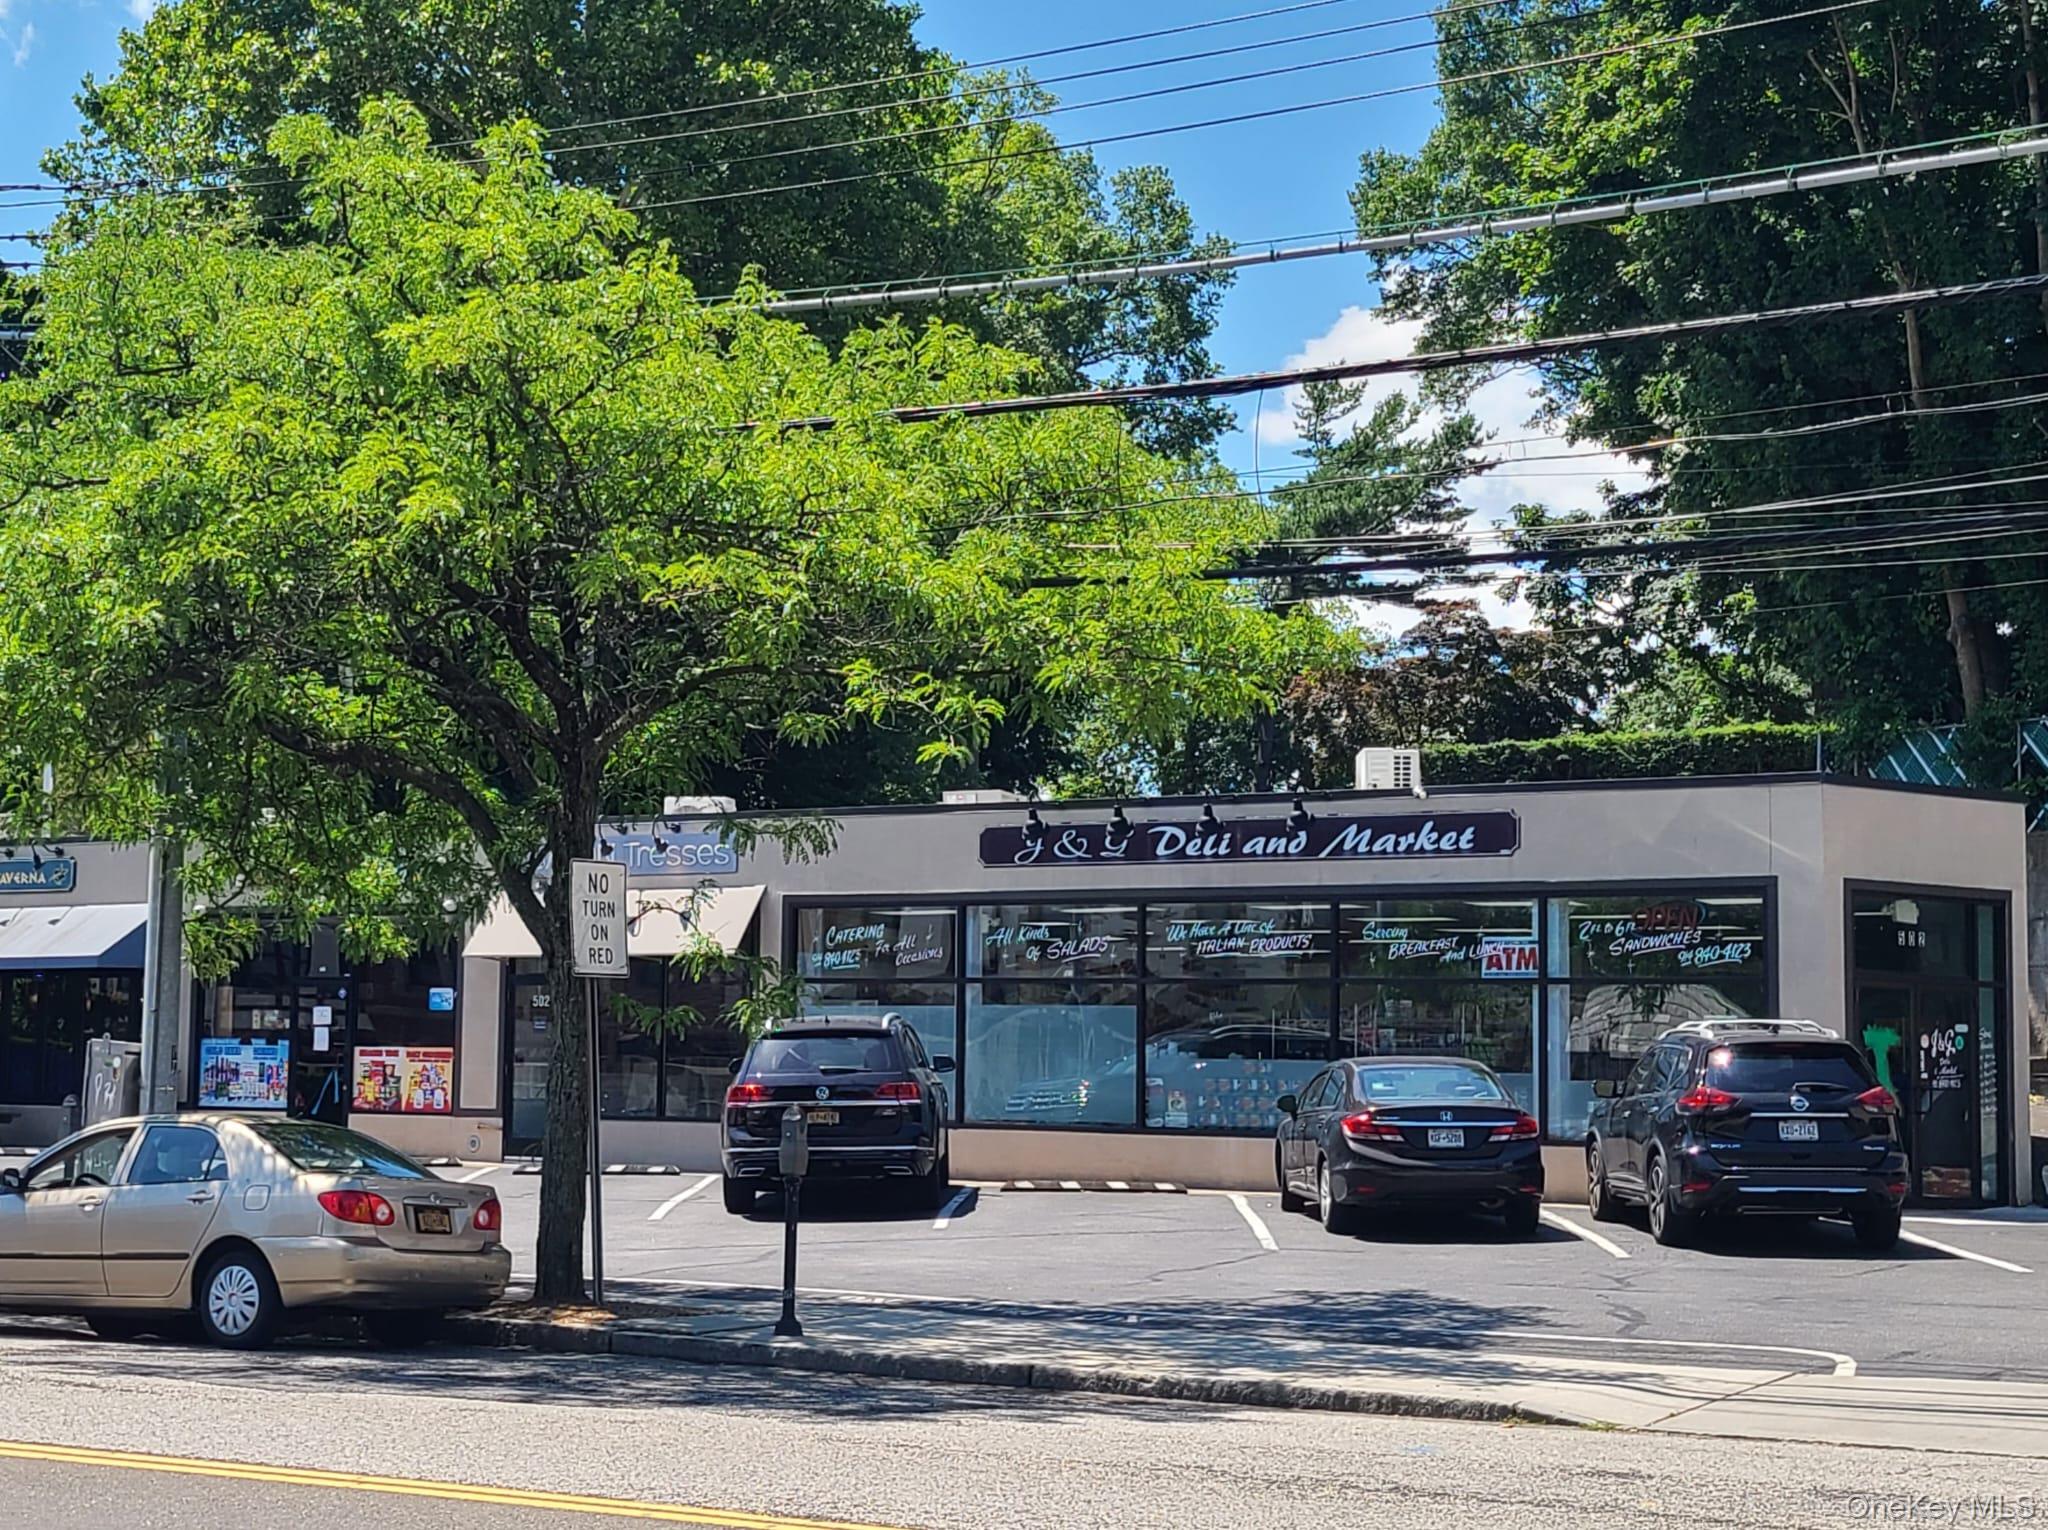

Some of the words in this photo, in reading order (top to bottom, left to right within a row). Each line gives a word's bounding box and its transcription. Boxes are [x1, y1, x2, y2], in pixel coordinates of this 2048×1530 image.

[1054, 830, 1092, 858] &
[1147, 826, 1231, 856] Deli
[1242, 830, 1307, 854] and
[1318, 820, 1476, 857] Market
[624, 842, 730, 867] Tresses
[0, 871, 46, 884] AVERNA
[588, 873, 609, 894] NO
[582, 900, 616, 918] TURN
[591, 924, 608, 941] ON
[985, 927, 1014, 948] All
[1197, 937, 1245, 955] ITALIAN
[1249, 934, 1313, 953] PRODUCTS
[1388, 936, 1460, 960] BREAKFAST
[1609, 931, 1702, 956] SANDWICHES
[589, 948, 614, 965] RED
[1485, 947, 1537, 970] ATM
[532, 995, 550, 1007] 502
